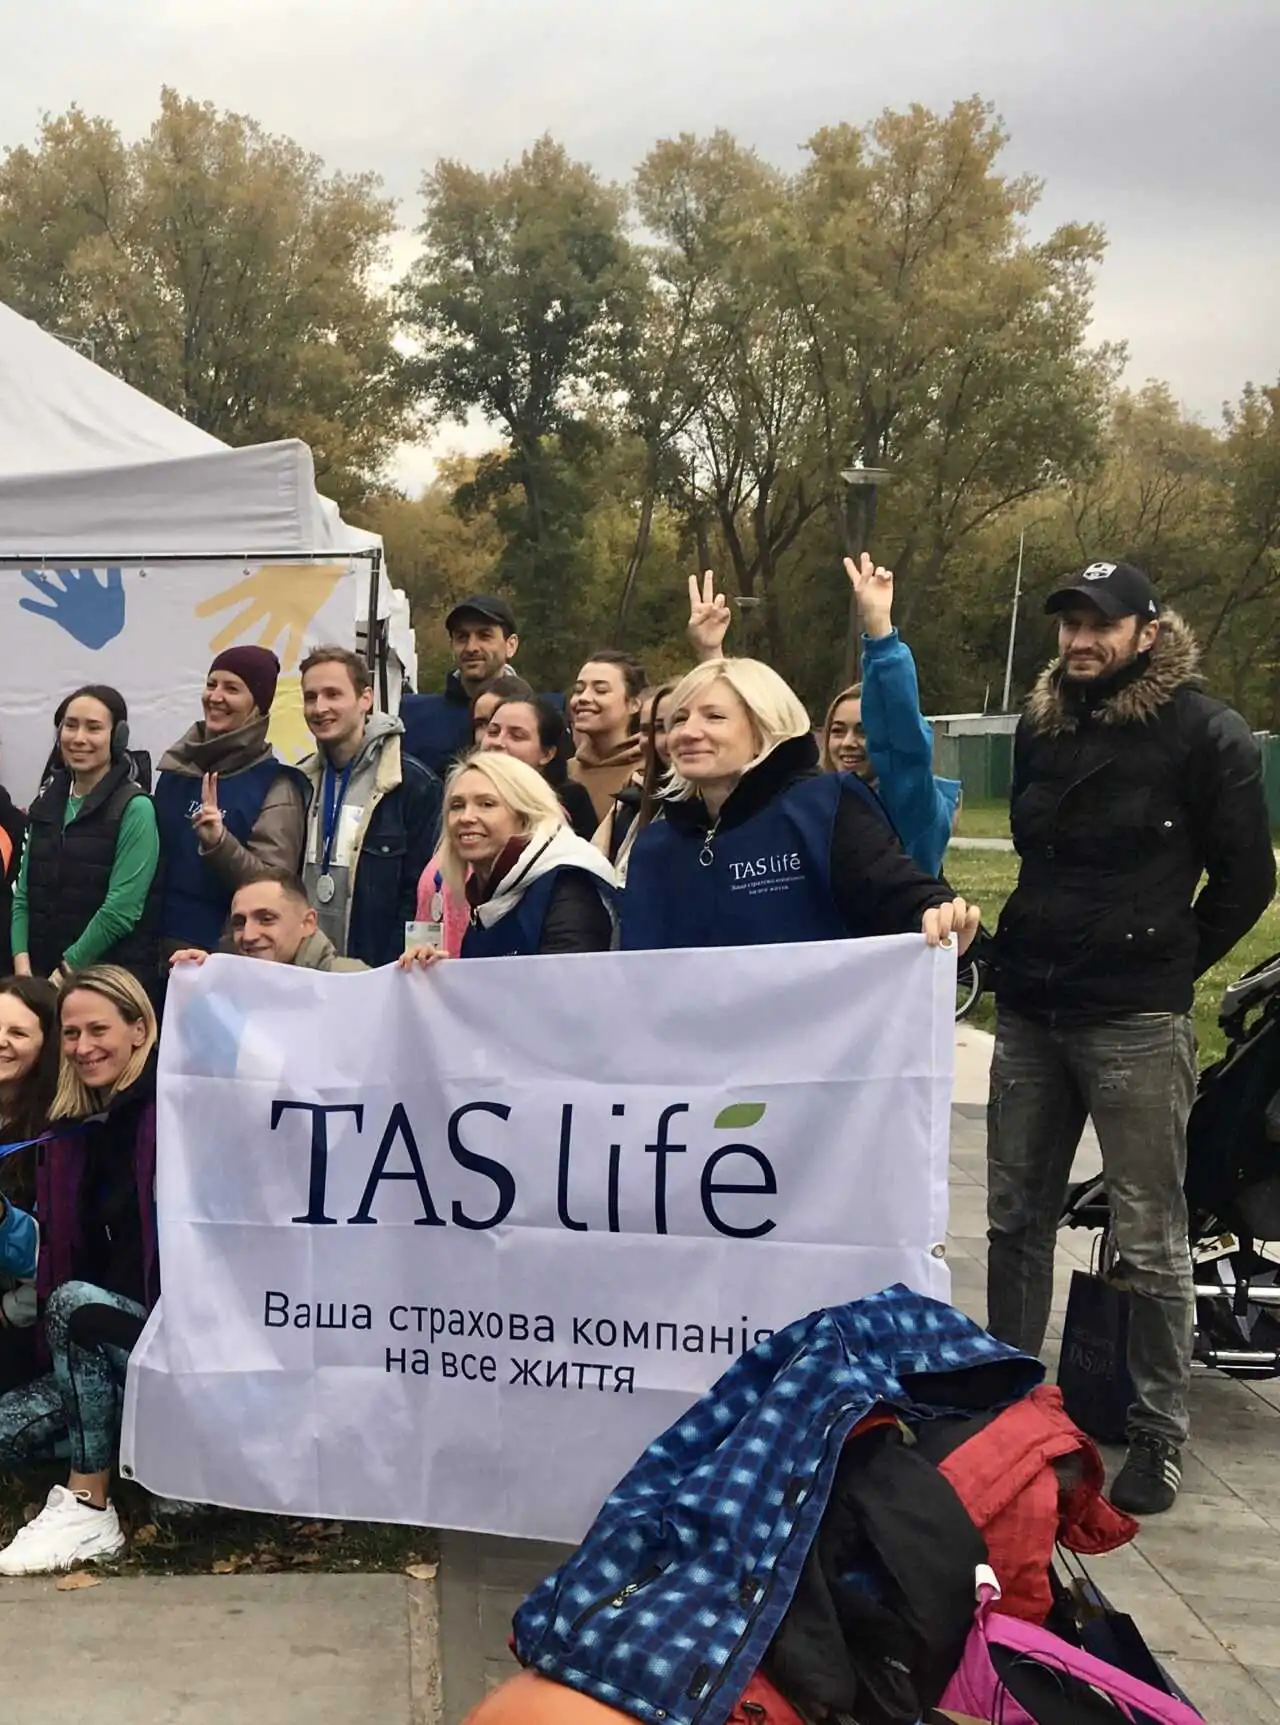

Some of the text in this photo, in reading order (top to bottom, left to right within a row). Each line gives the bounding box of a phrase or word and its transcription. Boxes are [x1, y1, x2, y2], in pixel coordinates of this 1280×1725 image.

[729, 857, 767, 880] TAS
[271, 1100, 516, 1230] TAS
[264, 1291, 372, 1330] Ваша
[389, 1305, 555, 1344] страхова
[385, 1347, 635, 1394] на все життя
